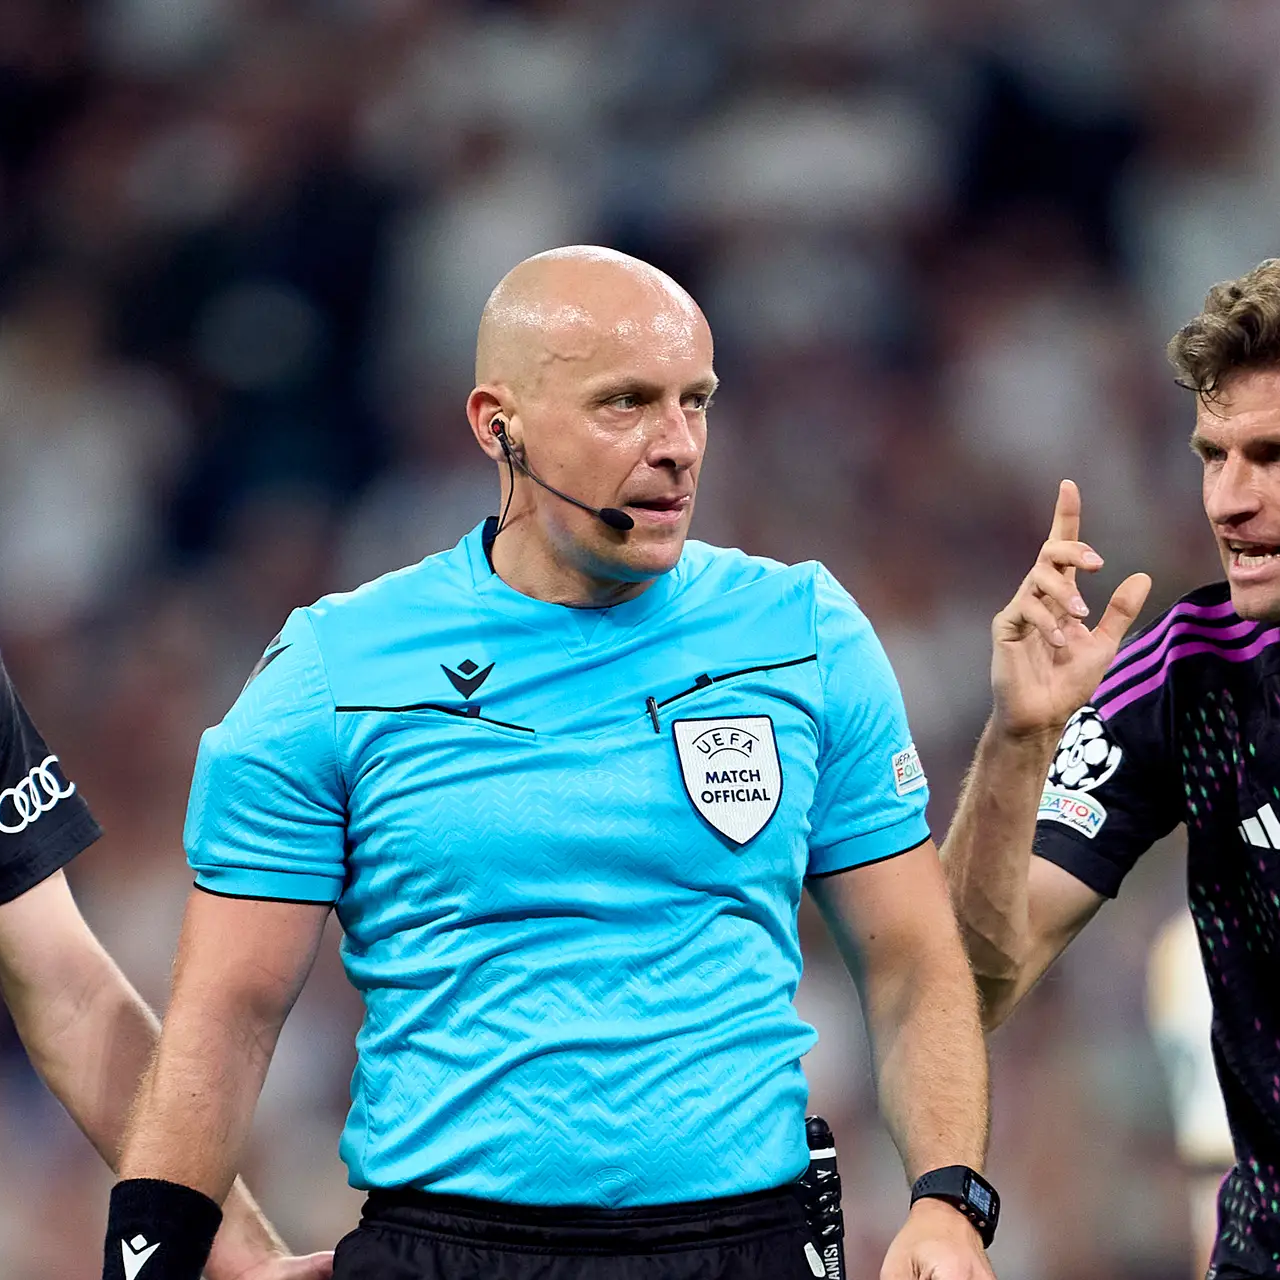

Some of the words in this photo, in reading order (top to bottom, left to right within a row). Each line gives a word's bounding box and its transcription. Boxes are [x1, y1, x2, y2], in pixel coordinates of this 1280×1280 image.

[697, 732, 753, 754] UEFA
[705, 769, 761, 784] MATCH
[701, 788, 771, 804] OFFICIAL
